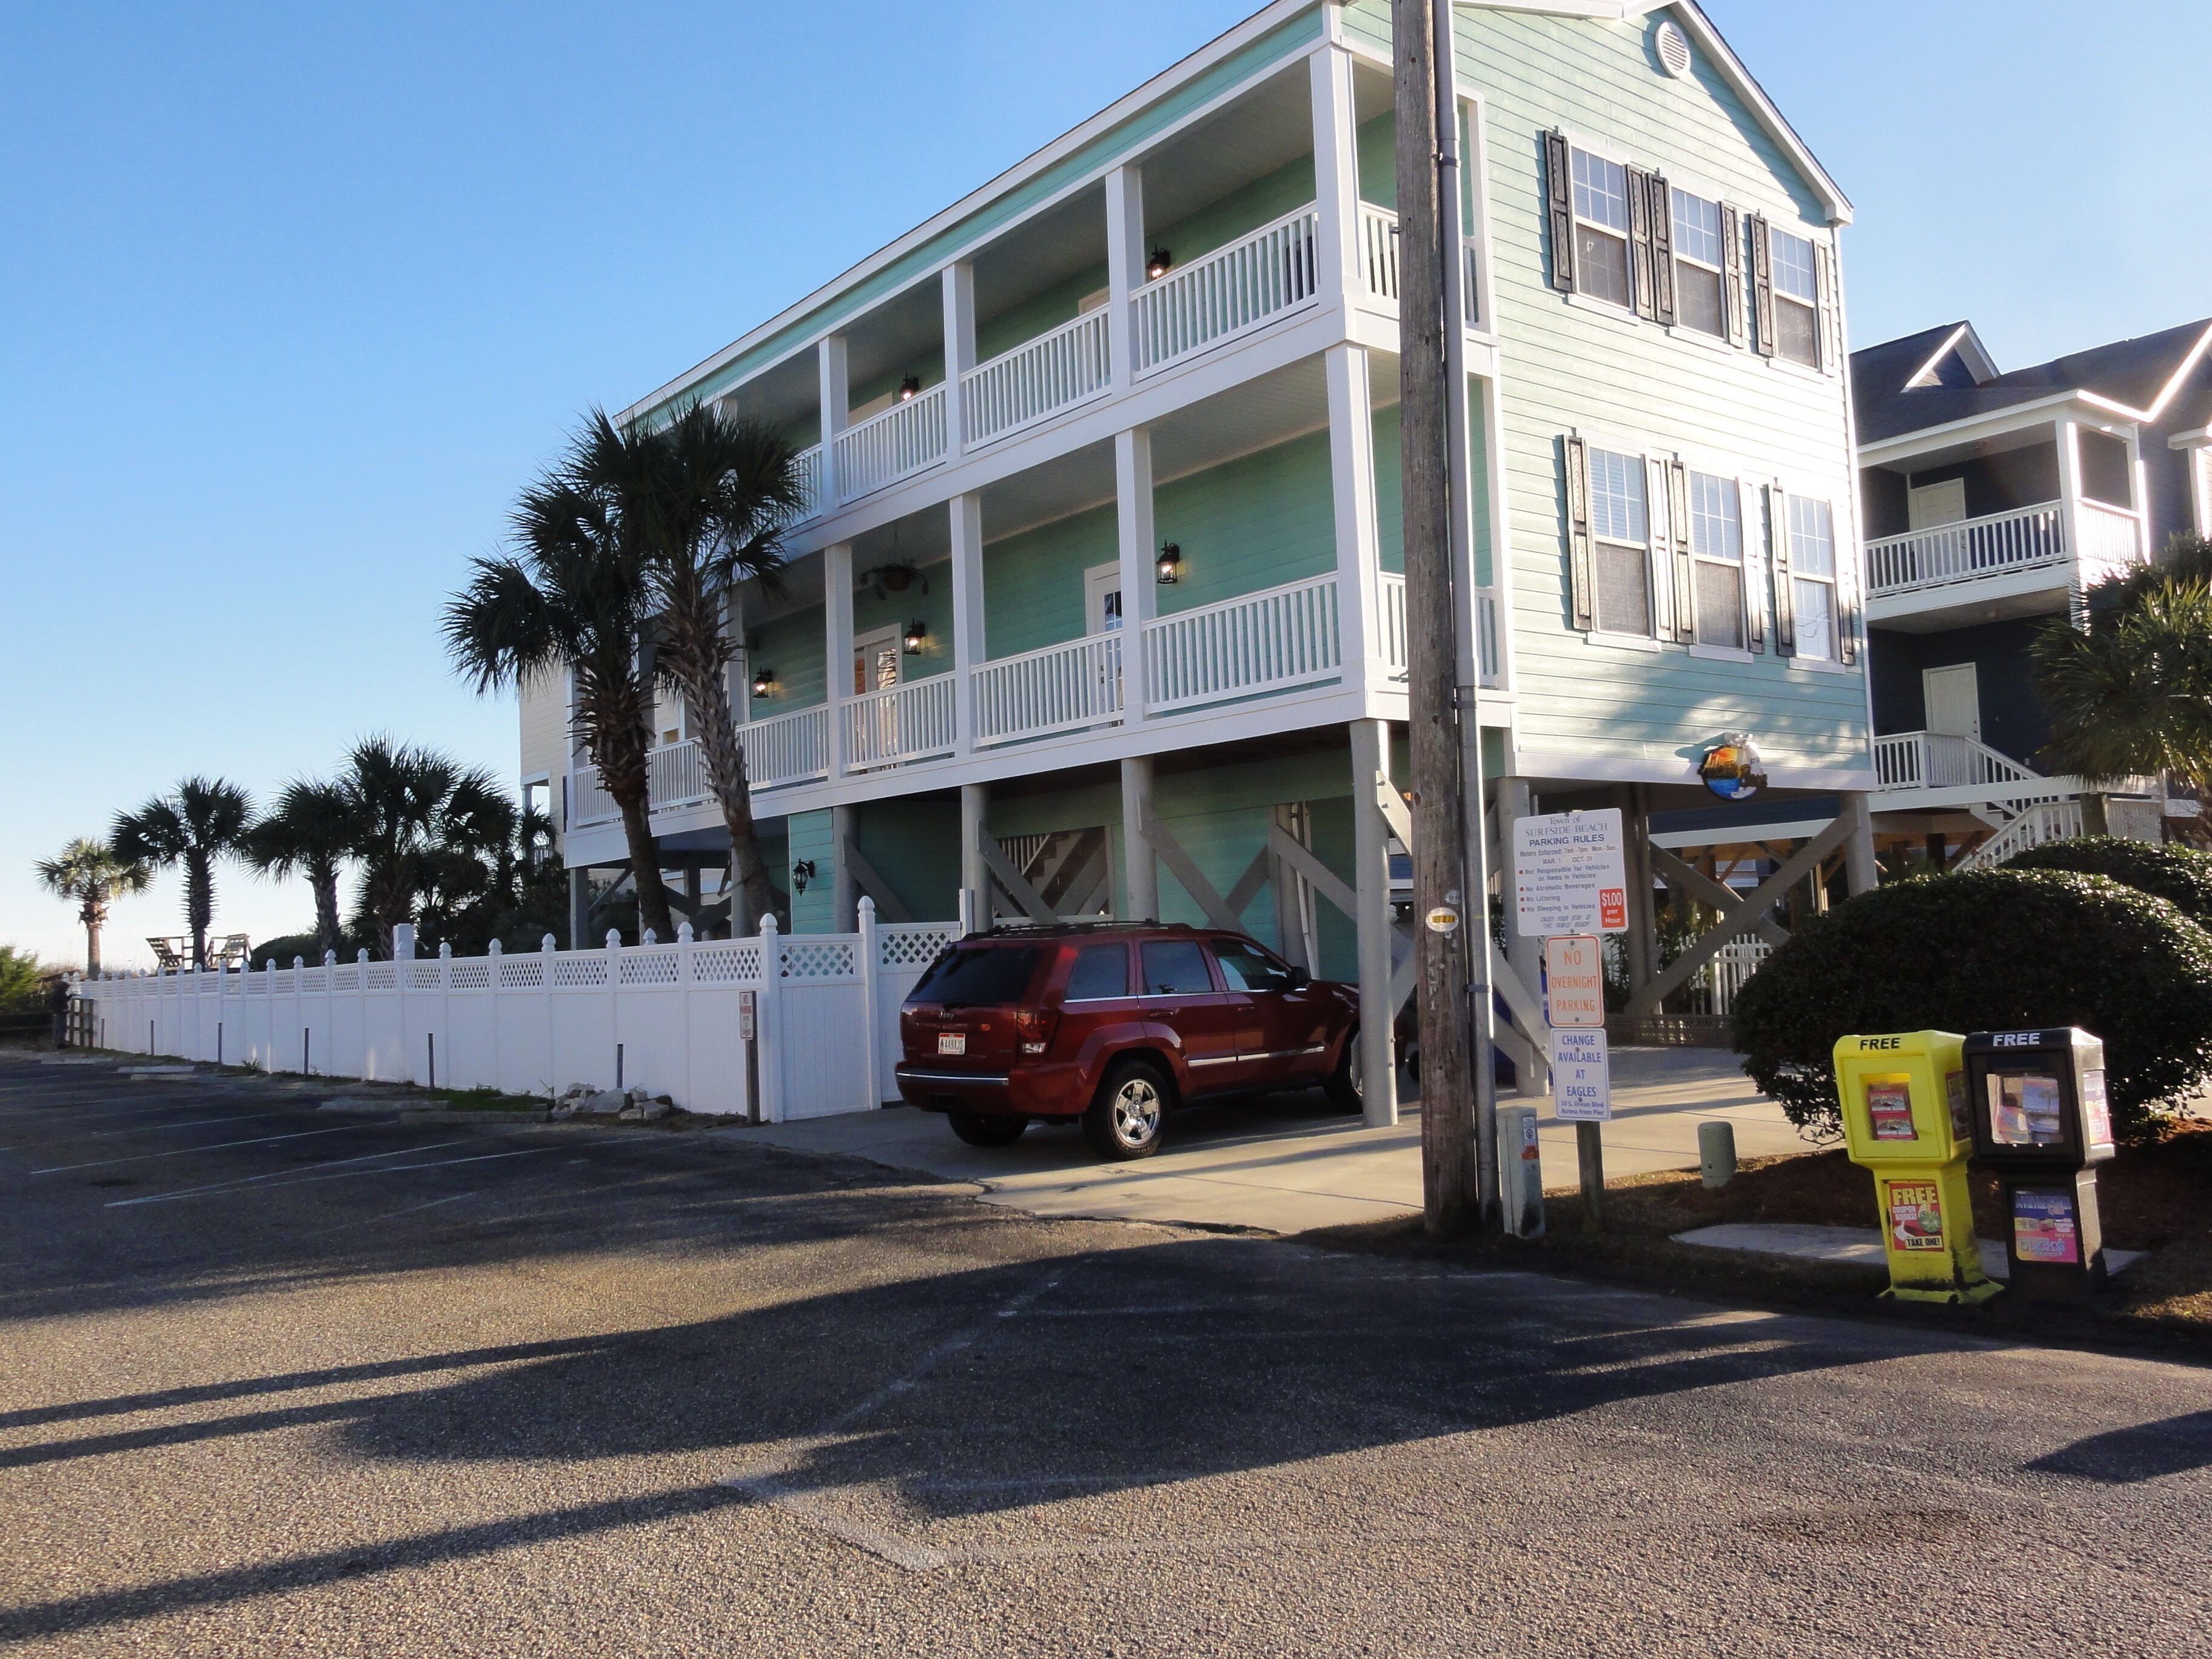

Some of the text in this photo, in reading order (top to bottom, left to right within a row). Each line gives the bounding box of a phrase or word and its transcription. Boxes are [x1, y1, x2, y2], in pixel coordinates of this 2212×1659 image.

[1525, 823, 1607, 837] SURFSIDE BEACH
[1529, 834, 1604, 846] PARKING RULES
[1537, 866, 1571, 874] Responsible
[1601, 893, 1622, 907] $1.00
[1564, 950, 1581, 966] NO
[1552, 976, 1597, 989] OVERNIGHT
[1557, 999, 1595, 1011] PARKING
[1562, 1035, 1595, 1045] CHANGE
[1860, 1037, 1900, 1051] FREE
[1993, 1033, 2040, 1047] FREE
[1558, 1052, 1601, 1062] AVAILABLE
[1575, 1070, 1586, 1079] AT
[1566, 1086, 1596, 1097] EAGLES
[1892, 1187, 1937, 1205] FREE
[1907, 1237, 1940, 1247] TAKE ONE!
